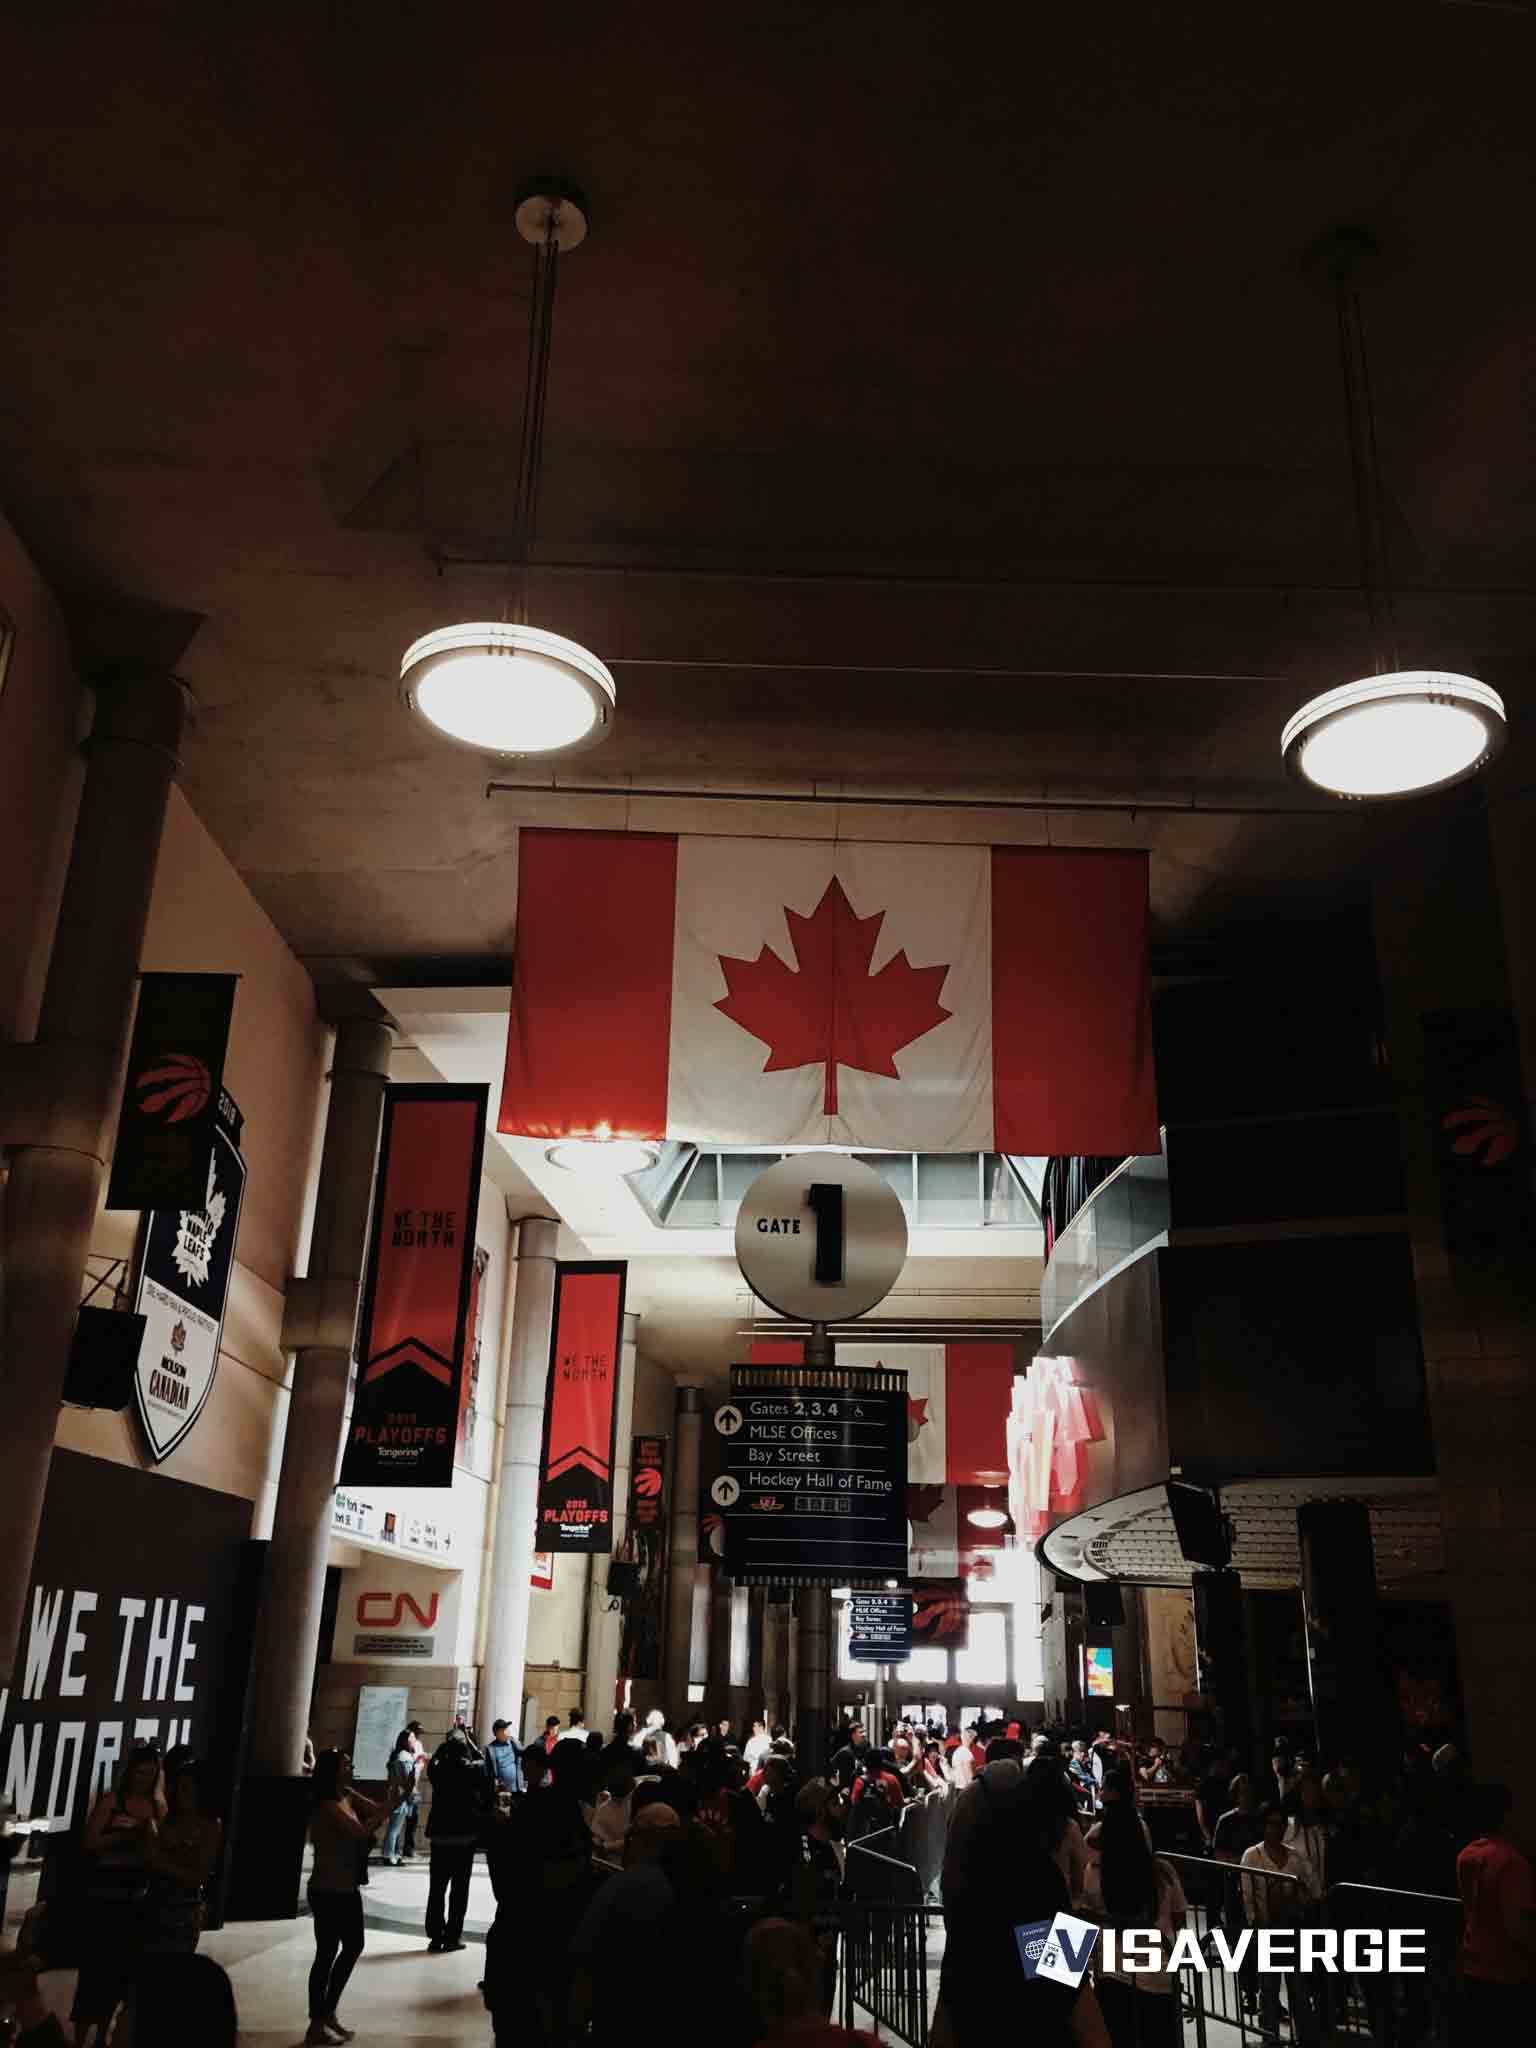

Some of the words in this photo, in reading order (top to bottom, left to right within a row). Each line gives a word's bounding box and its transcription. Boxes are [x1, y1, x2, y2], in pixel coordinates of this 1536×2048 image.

[420, 1210, 457, 1229] THE
[757, 1218, 801, 1234] GATE
[807, 1183, 843, 1282] 1
[750, 1401, 789, 1416] Gates
[354, 1424, 448, 1446] PLAYOFFS
[749, 1425, 787, 1439] MLSE
[790, 1425, 839, 1440] Offices
[377, 1446, 419, 1459] Tangerine
[748, 1447, 773, 1464] Bay
[778, 1447, 821, 1463] Street
[749, 1471, 802, 1489] Hockey
[806, 1473, 833, 1487] Hall
[838, 1474, 853, 1488] of
[856, 1475, 893, 1491] Fame
[543, 1508, 609, 1523] PLAYOFFS
[357, 1592, 440, 1628] CN
[22, 1585, 99, 1701] WE
[113, 1596, 206, 1702] THE
[3, 1718, 192, 1833] NOR
